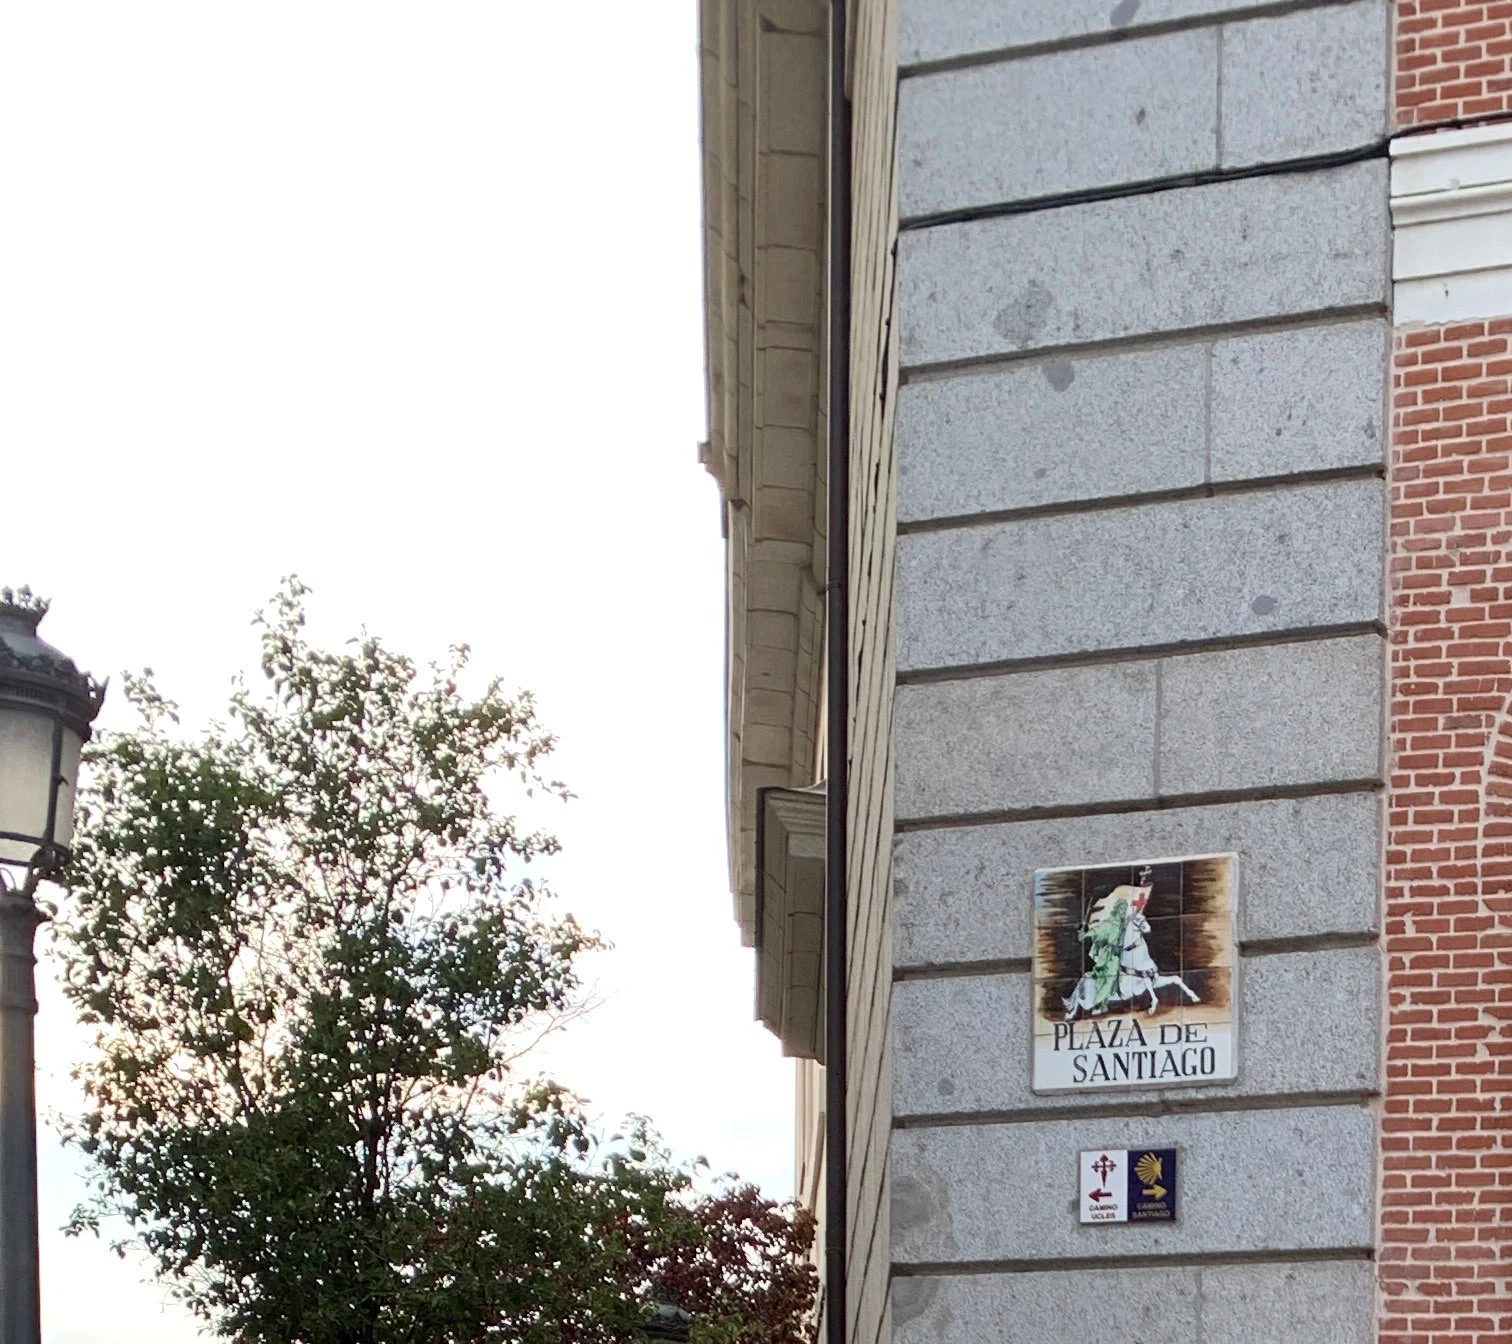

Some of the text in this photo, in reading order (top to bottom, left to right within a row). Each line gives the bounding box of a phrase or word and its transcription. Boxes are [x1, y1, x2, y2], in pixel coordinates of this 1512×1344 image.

[1053, 1018, 1208, 1051] PLAZA DE
[1073, 1046, 1216, 1083] SANTIAGO
[1089, 1203, 1118, 1212] CAMINO
